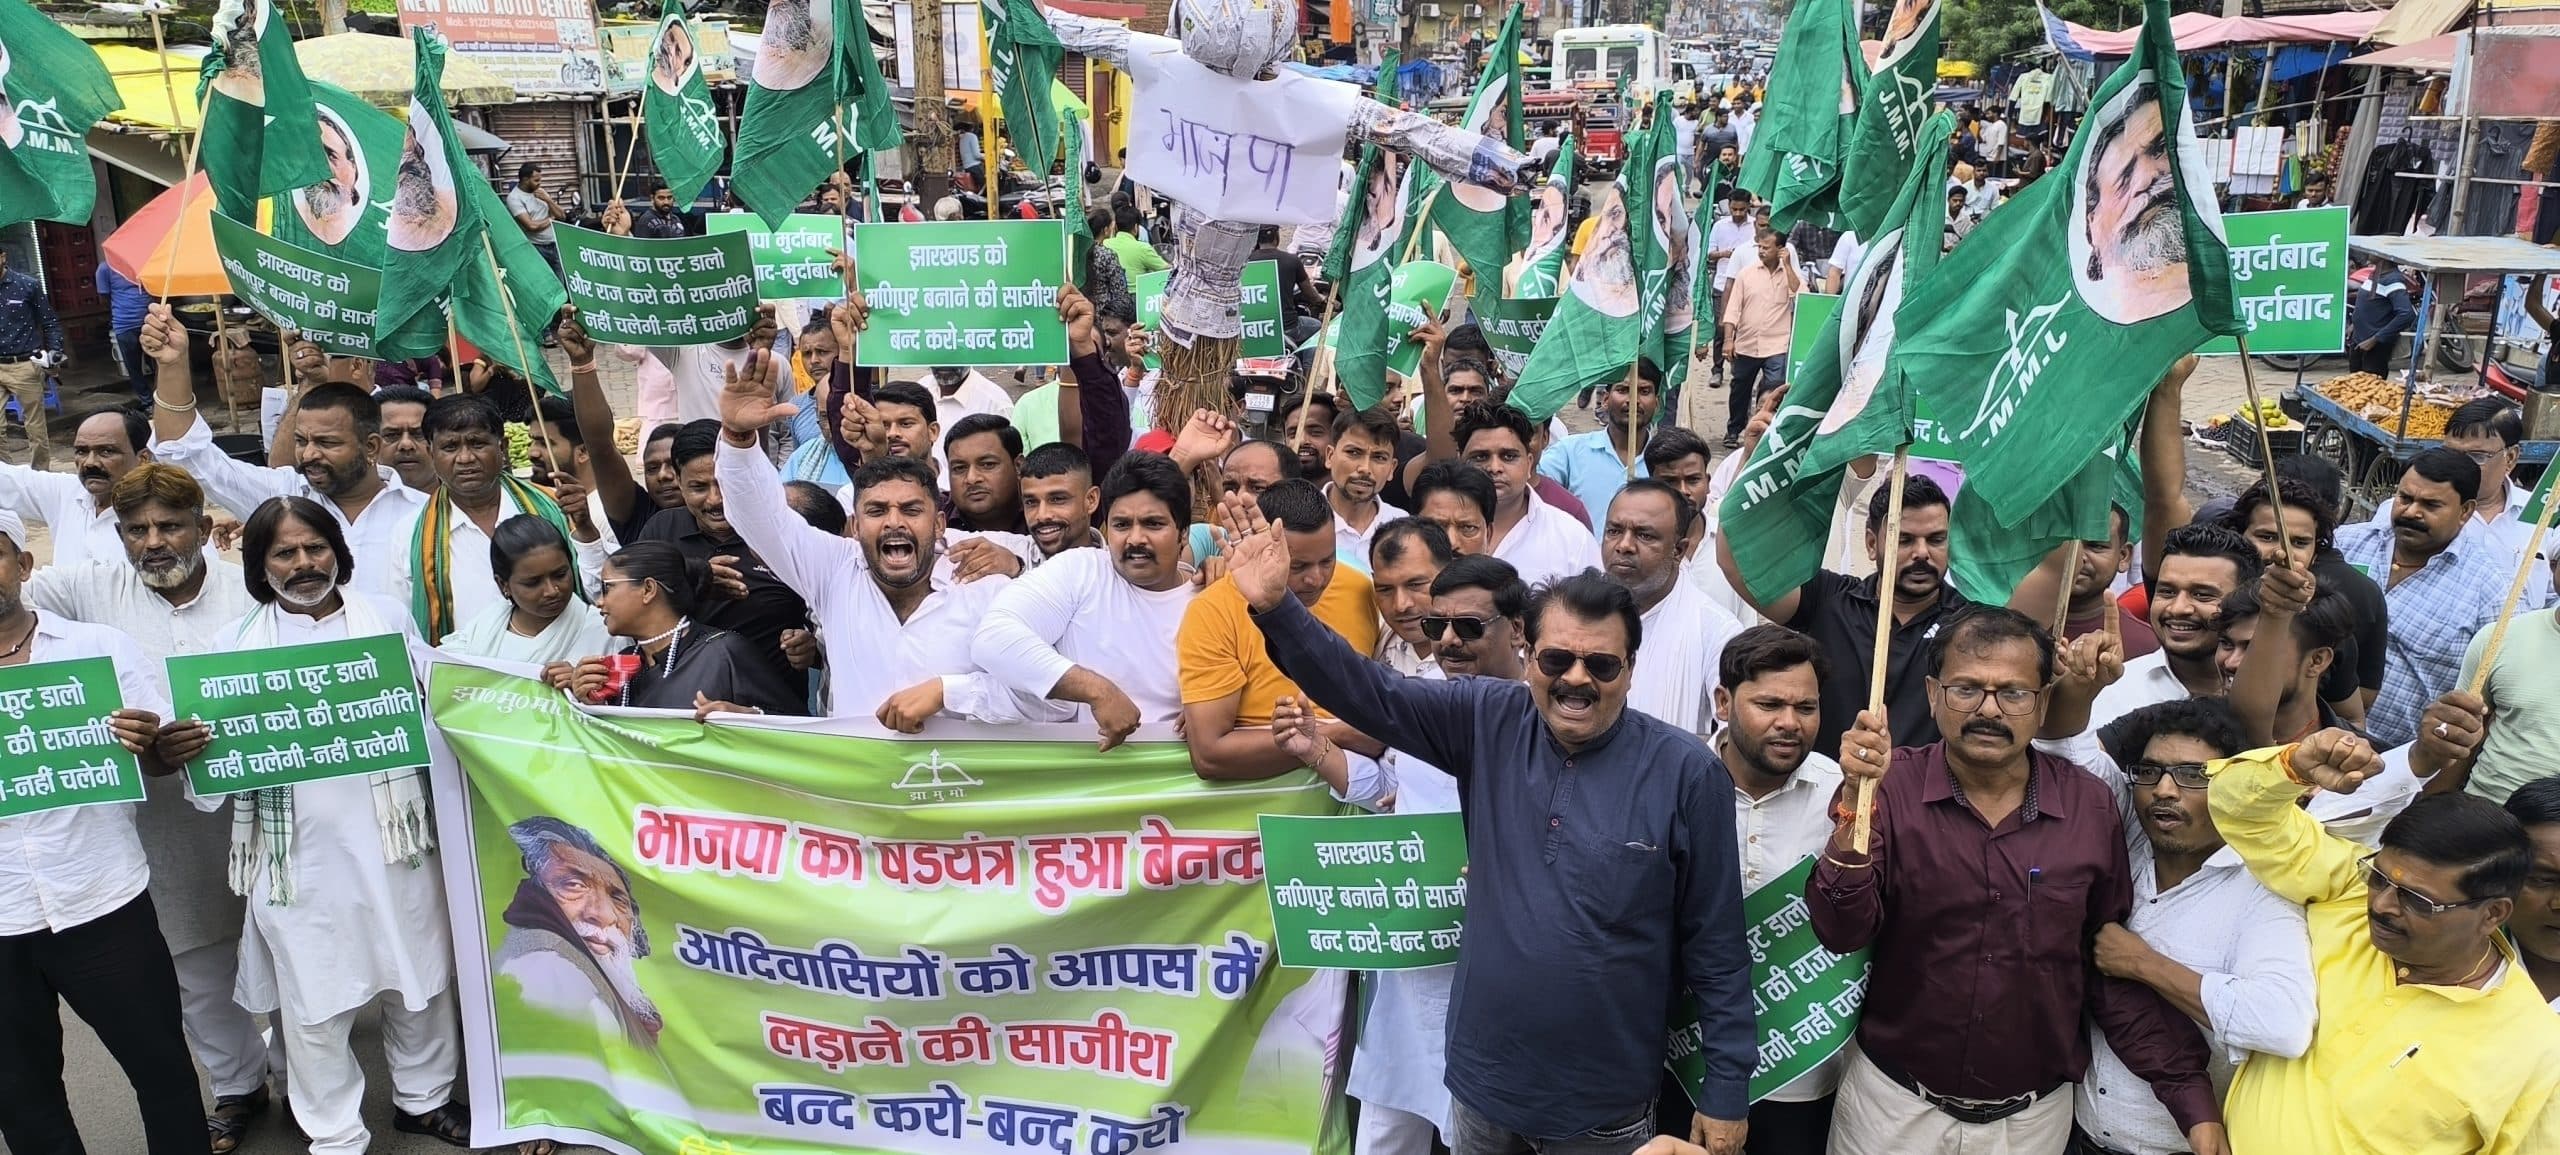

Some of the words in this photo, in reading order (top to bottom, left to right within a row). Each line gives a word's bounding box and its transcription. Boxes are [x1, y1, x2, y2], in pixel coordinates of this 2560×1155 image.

[1879, 90, 1910, 161] J.M.M.
[774, 227, 833, 254] मुर्दाबाद
[908, 244, 980, 271] झारखण्ड
[984, 236, 1007, 266] को
[256, 248, 324, 287] झारखण्ड
[326, 272, 350, 294] को
[579, 246, 625, 272] भाजपा
[627, 254, 651, 274] का
[688, 247, 725, 273] डालो
[268, 282, 311, 313] बनाने
[314, 300, 338, 320] की
[569, 270, 593, 297] और
[596, 283, 622, 303] राज
[626, 282, 658, 305] करो
[661, 282, 686, 304] की
[689, 275, 752, 303] राजनीति
[865, 280, 919, 316] मणिपुर
[923, 279, 969, 308] बनाने
[973, 279, 998, 308] की
[583, 310, 611, 332] नहीं
[699, 306, 747, 332] चलेगी
[889, 328, 920, 350] बन्द
[925, 321, 996, 350] करो-बन्द
[1001, 320, 1034, 350] करो
[338, 332, 370, 350] करो
[37, 676, 86, 708] डालो
[200, 673, 260, 699] भाजपा
[263, 669, 293, 692] का
[334, 652, 379, 683] डालो
[220, 713, 259, 739] राज
[261, 703, 302, 732] करो
[304, 699, 334, 727] की
[336, 687, 415, 722] राजनीति
[4, 725, 38, 755] की
[205, 750, 245, 779] नहीं
[247, 736, 350, 775] चलेगी-नहीं
[352, 726, 410, 760] चलेगी
[58, 757, 120, 790] चलेगी
[638, 810, 787, 875] भाजपा
[799, 827, 862, 881] का
[872, 835, 1015, 886] षडयंत्र
[1029, 837, 1127, 908] हुआ
[1141, 819, 1264, 887] बेनक
[1314, 841, 1394, 869] झारखण्ड
[1397, 831, 1426, 863] को
[1274, 878, 1336, 916] मणिपुर
[1337, 878, 1390, 909] बनाने
[1392, 878, 1420, 909] की
[1308, 929, 1344, 952] बन्द
[1346, 922, 1426, 954] करो-बन्द
[679, 928, 940, 997] आदिवासियों
[954, 947, 1031, 993] को
[1049, 949, 1198, 992] आपस
[1212, 936, 1263, 994] में
[1760, 965, 1799, 1003] की
[765, 1015, 903, 1070] लड़ाने
[917, 1016, 991, 1062] की
[1005, 1012, 1172, 1081] साजीश
[759, 1088, 855, 1130] बन्द
[1090, 1106, 1185, 1155] करो
